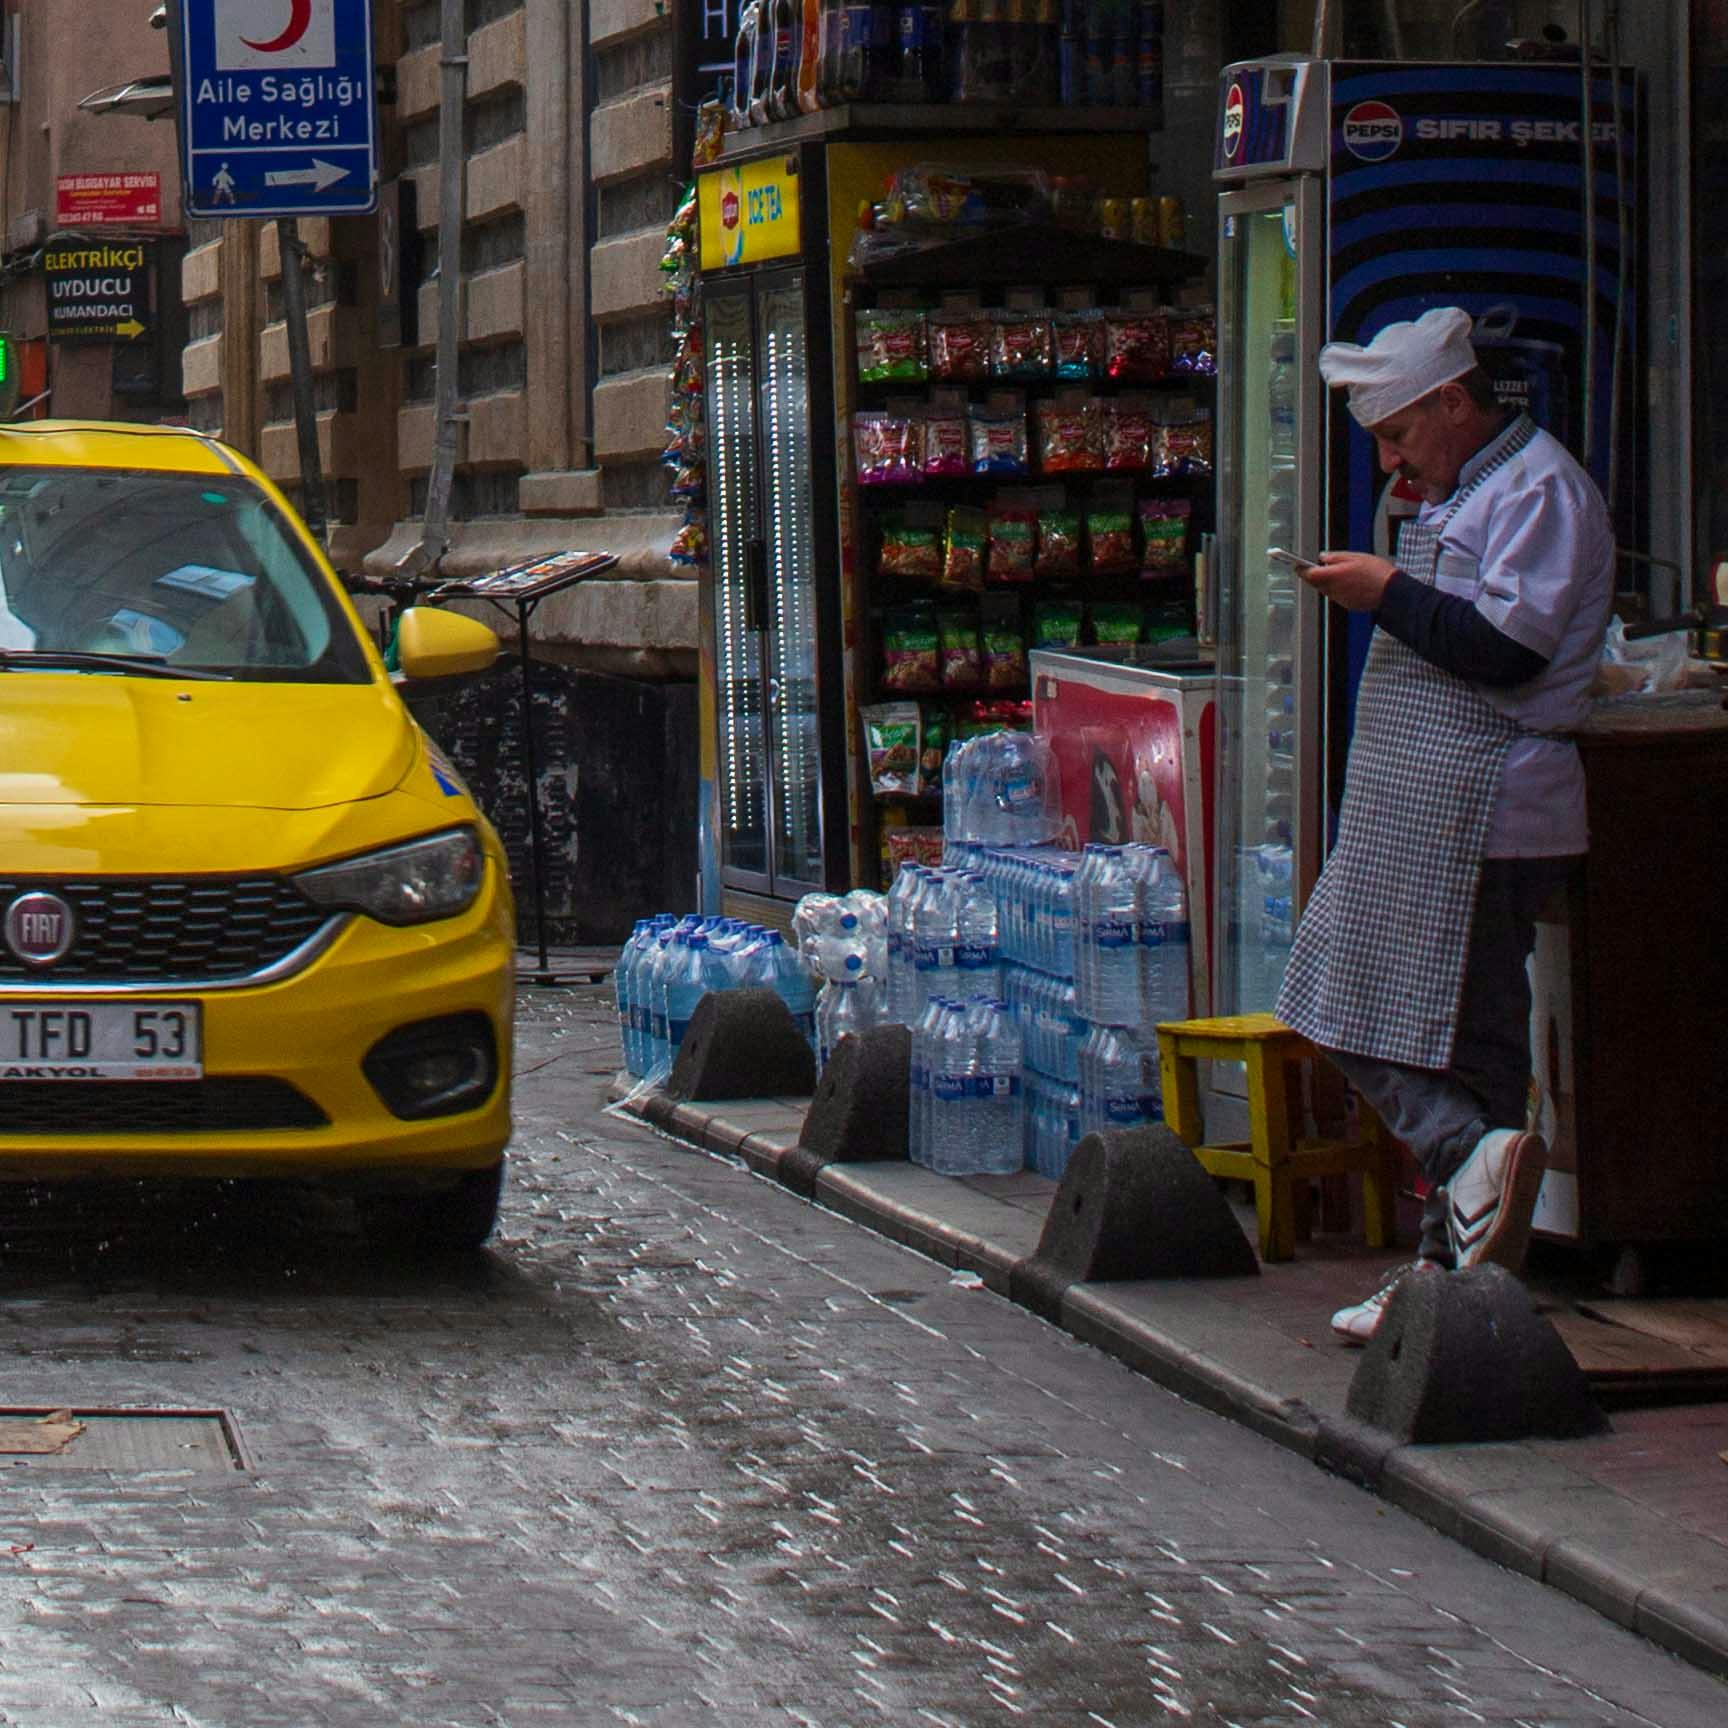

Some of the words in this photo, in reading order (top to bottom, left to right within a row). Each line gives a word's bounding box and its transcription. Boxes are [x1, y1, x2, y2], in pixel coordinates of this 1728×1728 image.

[196, 78, 251, 104] Aile
[260, 75, 362, 107] Sağlığı
[224, 114, 339, 141] Merkezi
[1346, 123, 1401, 139] PEPSI
[1416, 120, 1501, 141] SIFIR
[1511, 120, 1621, 146] ŞEKER
[45, 246, 145, 271] ELEKTRİKÇİ
[53, 278, 131, 297] UYDUCU
[54, 304, 133, 319] KUMANDACI
[22, 913, 60, 944] FIAT
[11, 1010, 92, 1058] TFD
[133, 1010, 187, 1058] 53
[3, 1066, 106, 1078] AKYOL
